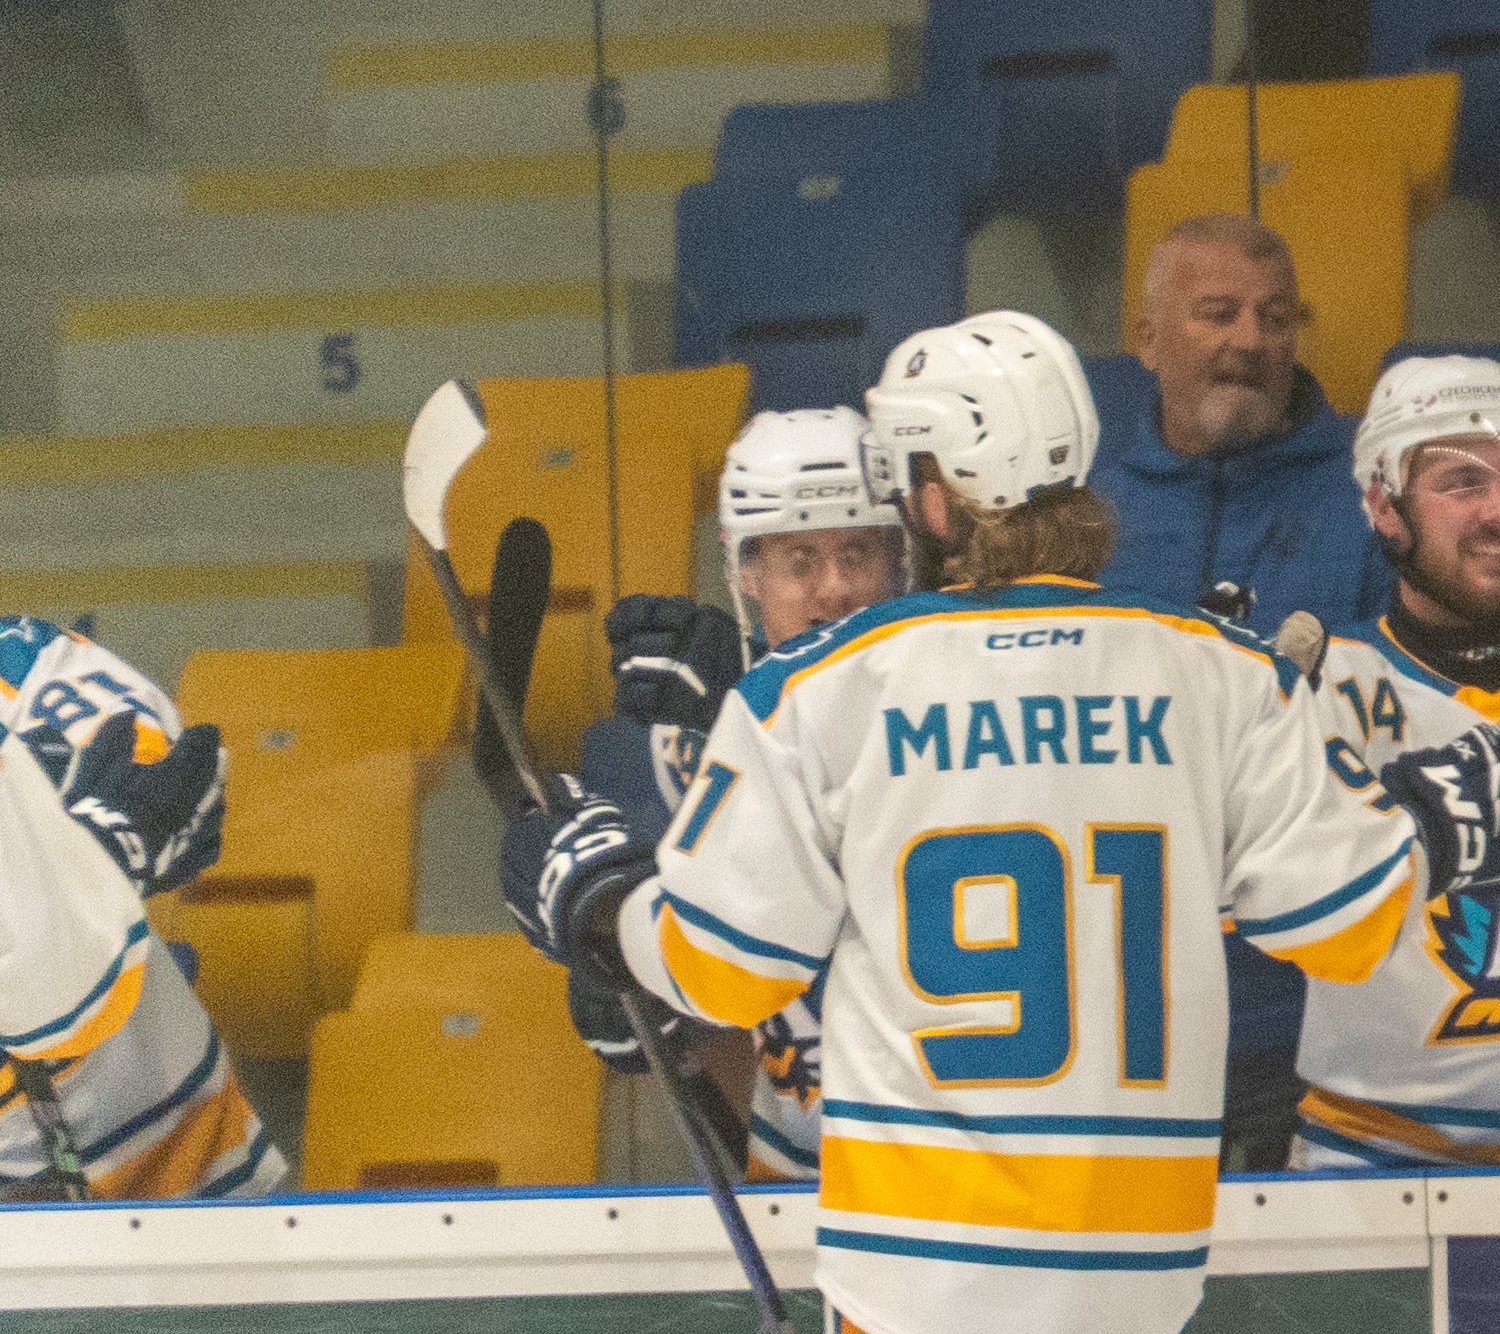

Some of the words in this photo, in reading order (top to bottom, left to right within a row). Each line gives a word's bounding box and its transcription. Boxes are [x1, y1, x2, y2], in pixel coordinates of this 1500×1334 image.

[322, 334, 360, 393] 5
[986, 628, 1086, 650] CCM
[883, 694, 1174, 779] MAREK
[1333, 677, 1408, 743] 14
[896, 823, 1170, 1090] 91
